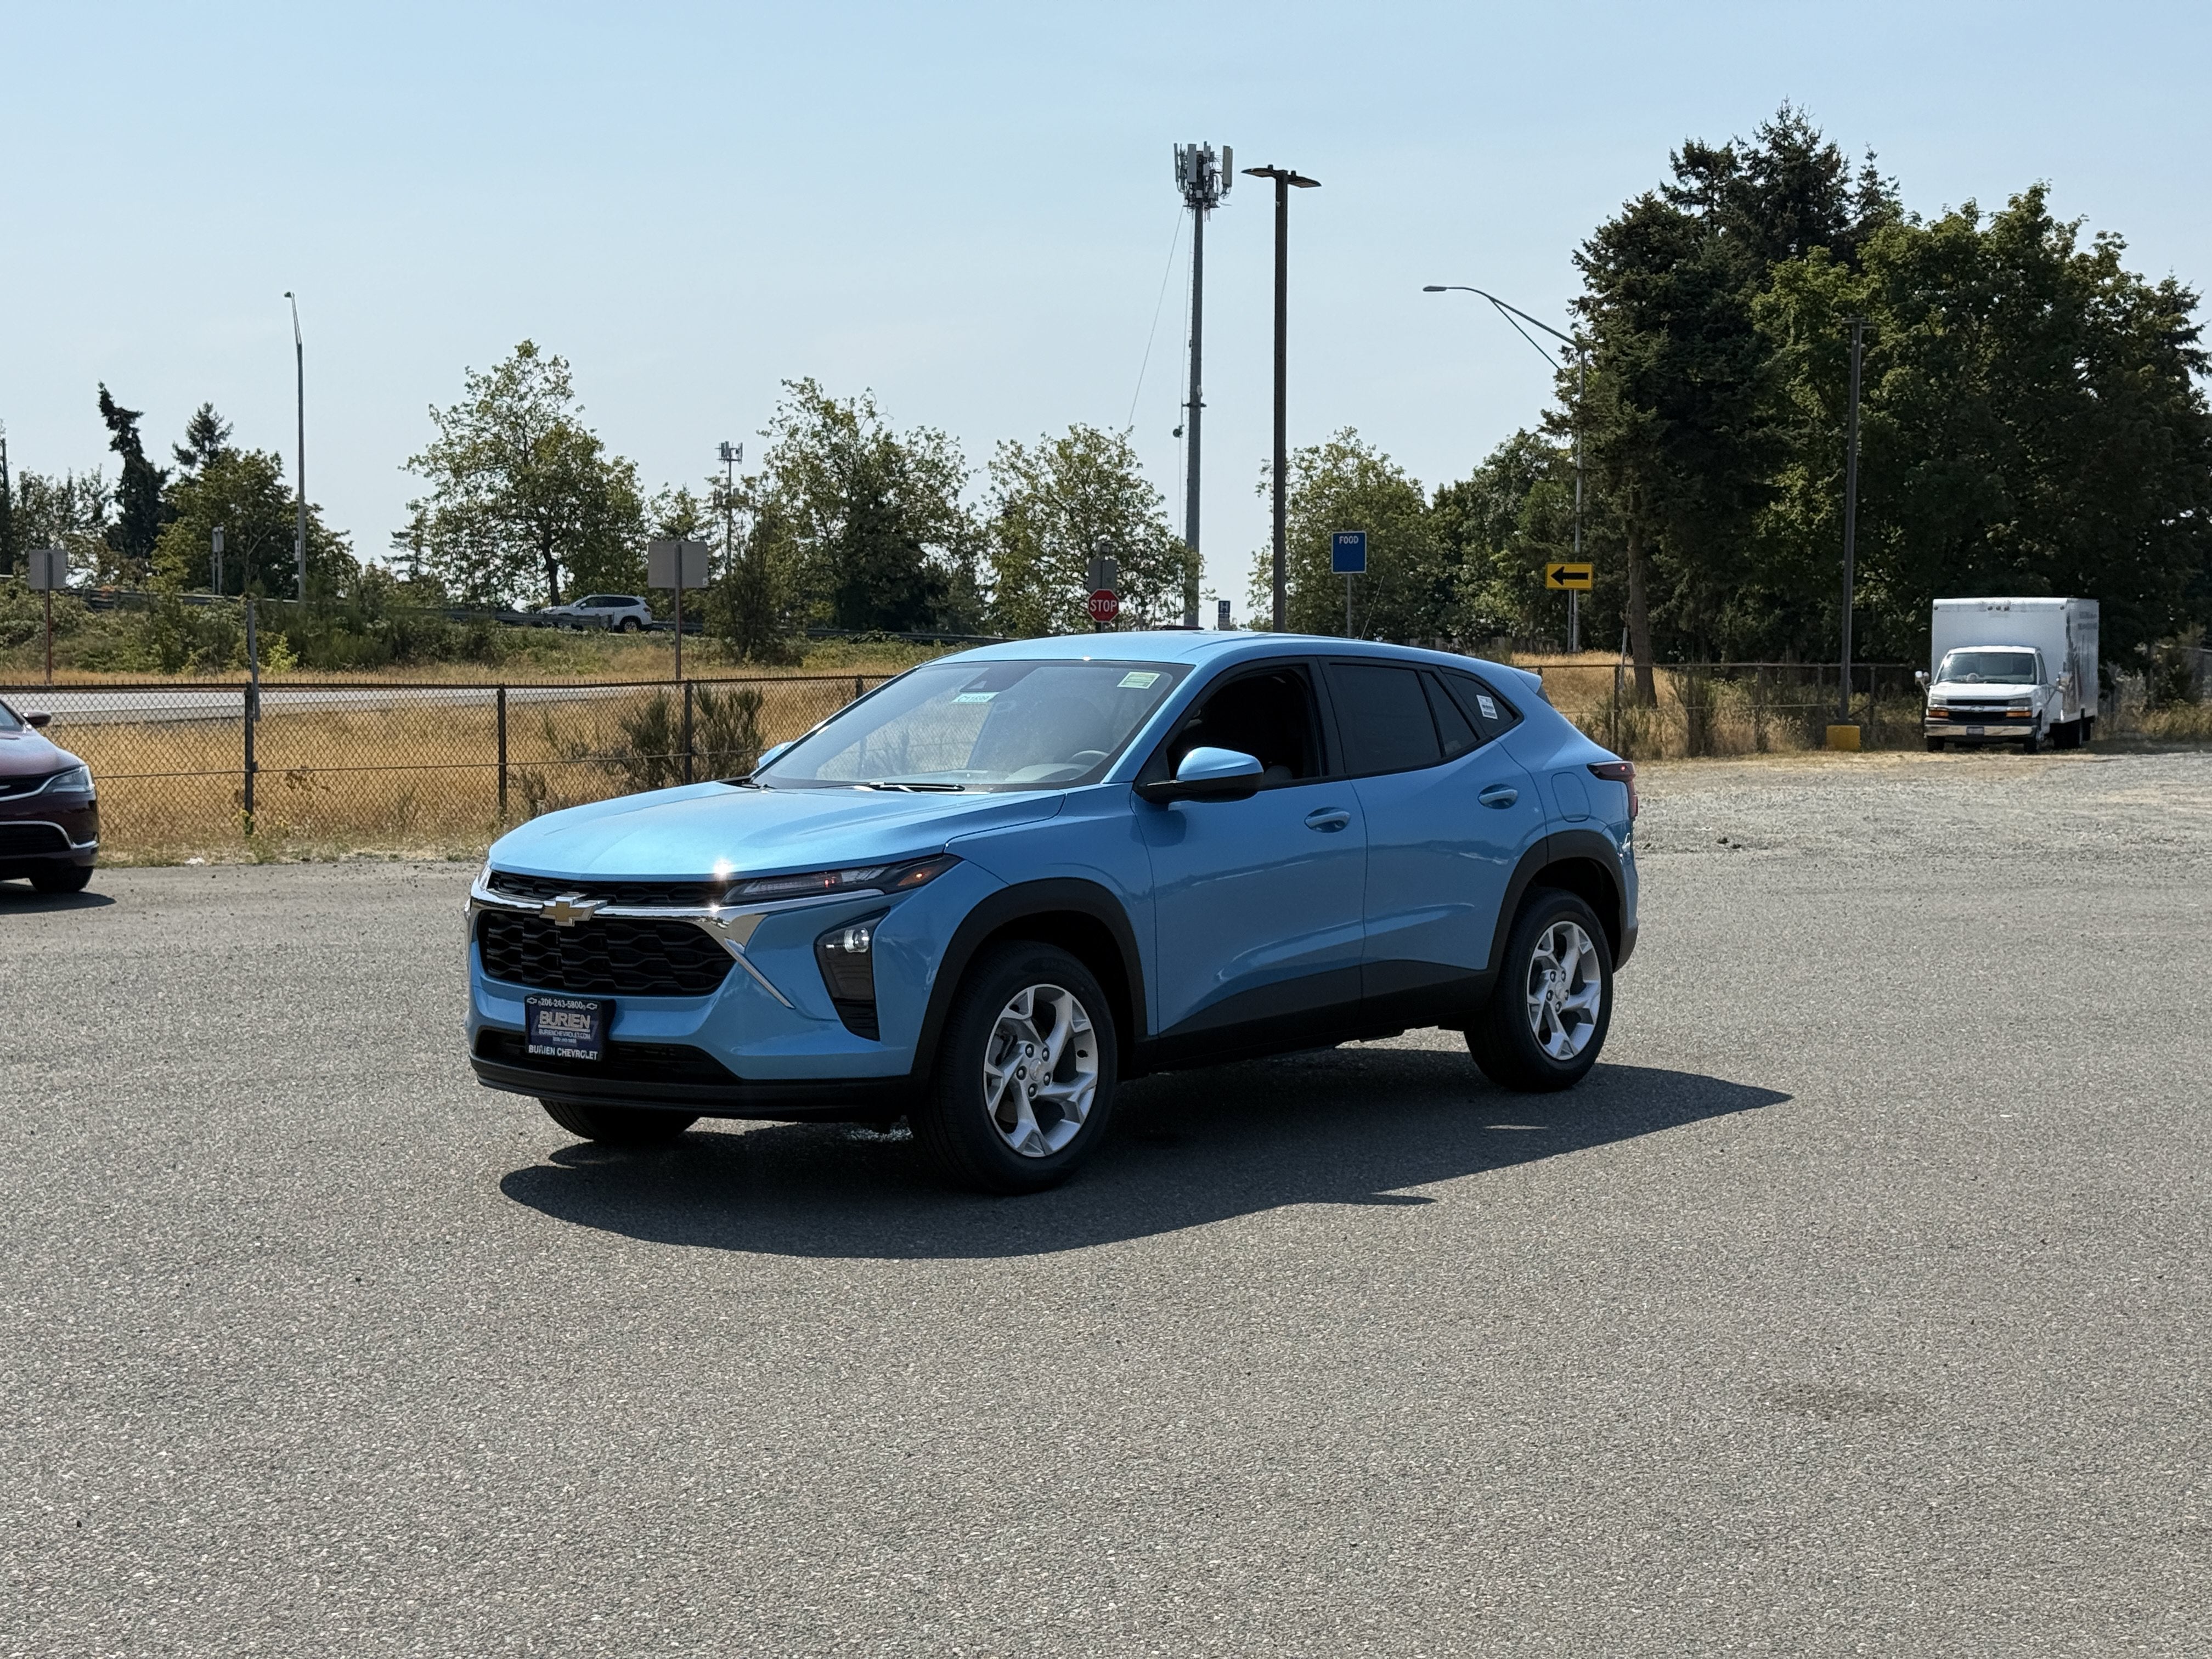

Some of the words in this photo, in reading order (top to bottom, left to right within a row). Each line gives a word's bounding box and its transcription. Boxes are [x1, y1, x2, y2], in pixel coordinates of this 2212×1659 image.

[1339, 535, 1359, 544] FOOD
[1090, 599, 1117, 612] STOP
[1220, 602, 1228, 612] H
[540, 997, 583, 1009] 206-243-5800
[539, 1011, 591, 1029] BURIEN
[529, 1045, 555, 1055] BURIEN
[557, 1048, 598, 1060] CHEVROLET
